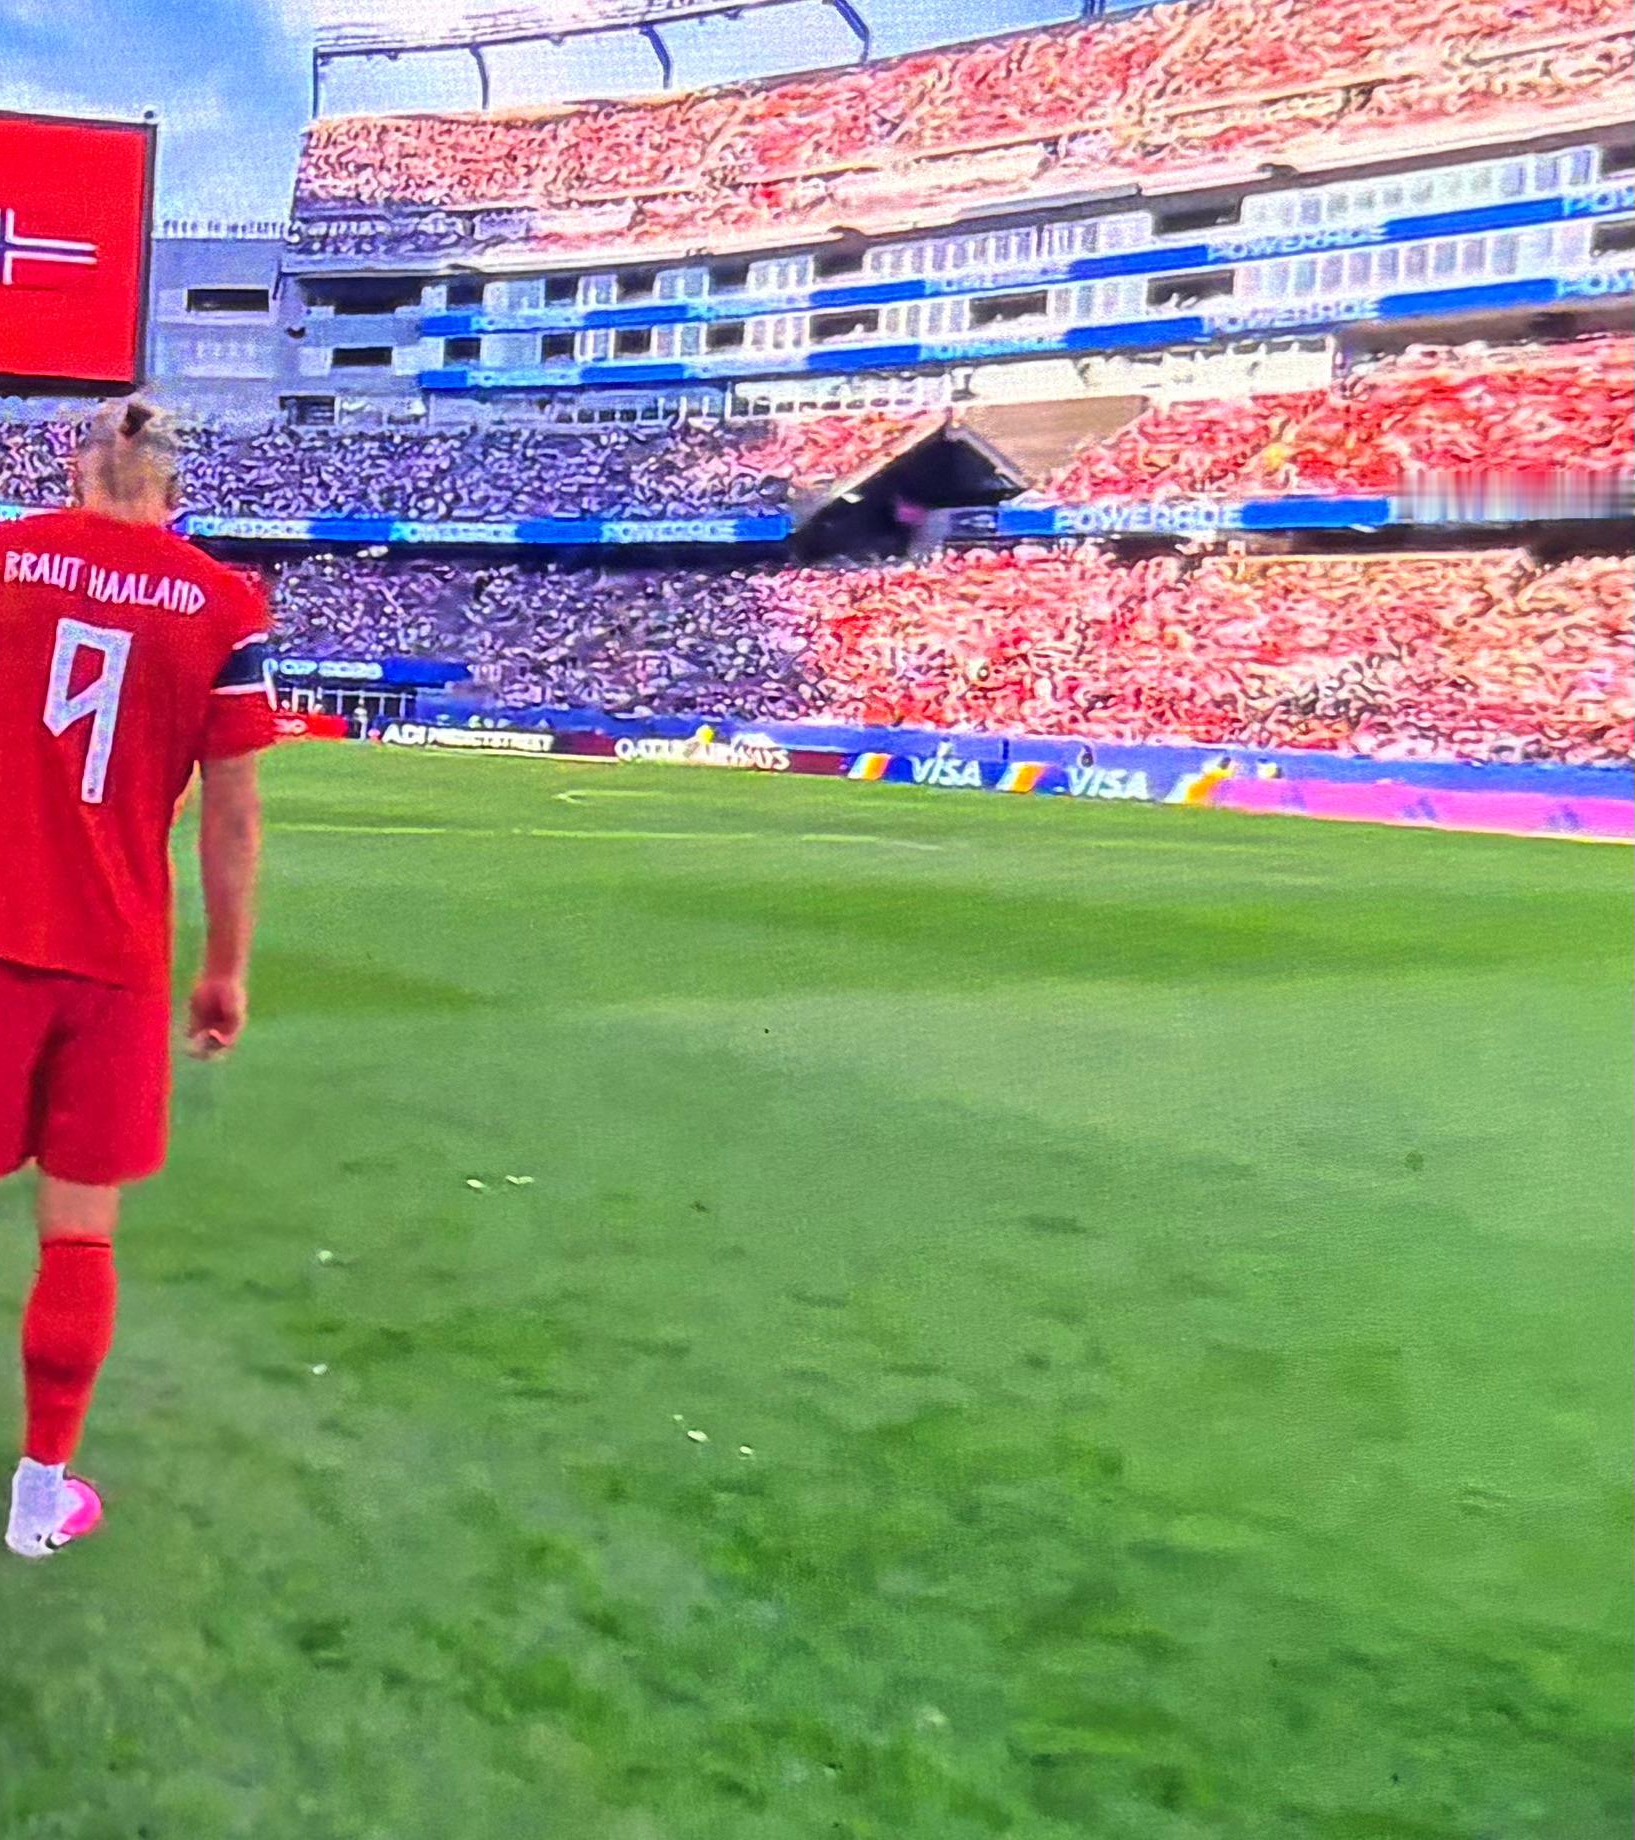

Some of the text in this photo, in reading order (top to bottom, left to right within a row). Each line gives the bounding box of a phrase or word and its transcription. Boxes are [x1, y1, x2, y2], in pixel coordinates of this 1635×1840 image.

[4, 551, 206, 615] BRAUT HAALAND
[43, 618, 133, 804] 9
[910, 755, 982, 786] VISA
[1067, 765, 1150, 799] VISA
